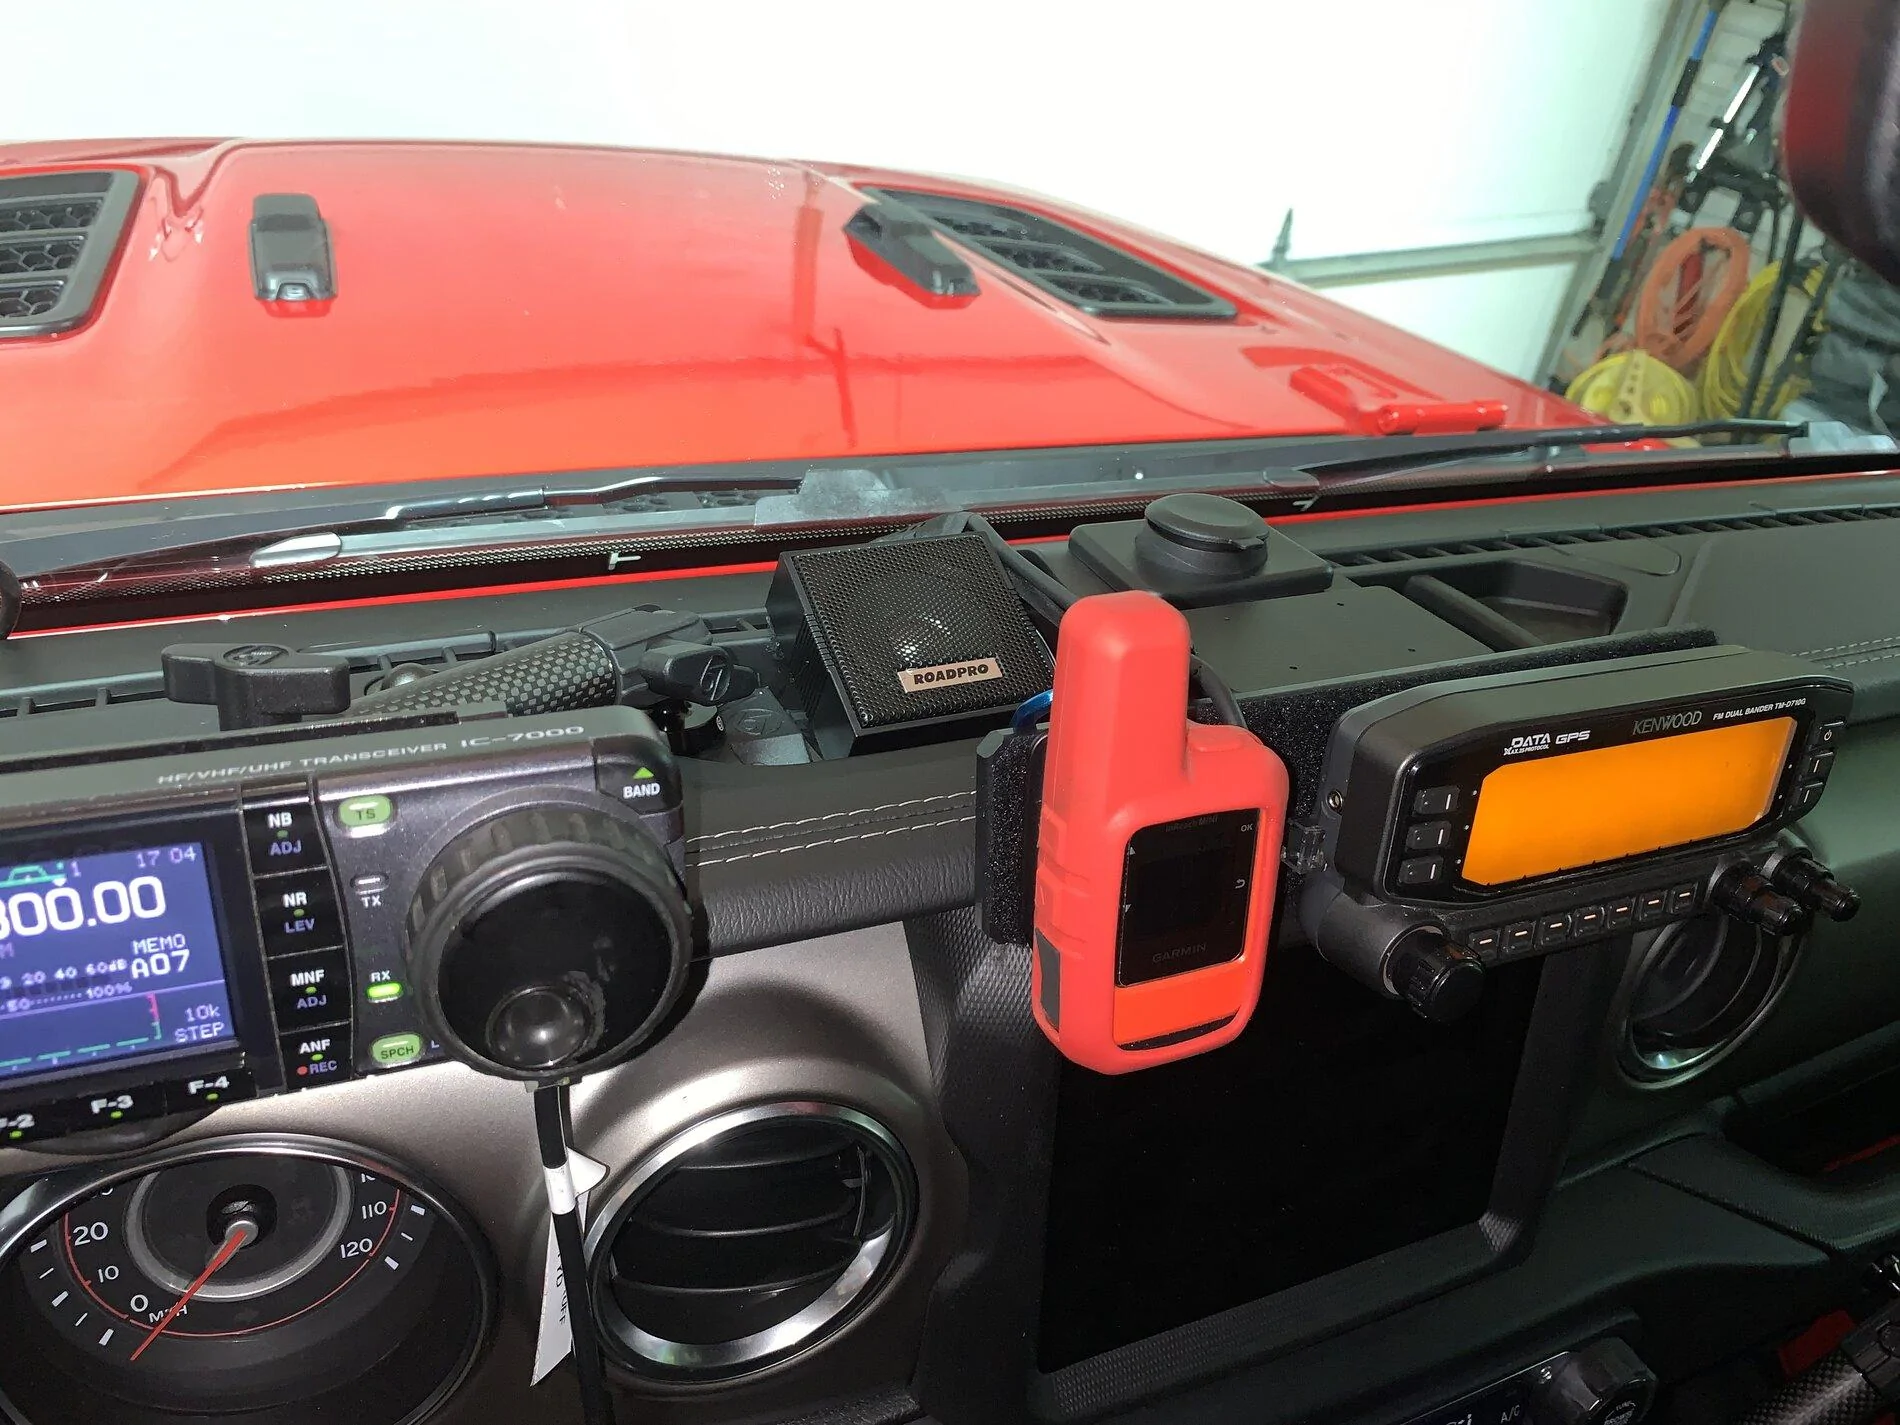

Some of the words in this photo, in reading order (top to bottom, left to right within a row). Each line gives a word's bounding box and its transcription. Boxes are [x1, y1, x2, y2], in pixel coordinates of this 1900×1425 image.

[914, 664, 989, 684] ROADPRO
[1712, 712, 1724, 721] FM
[1725, 709, 1743, 719] DUAL
[1744, 704, 1774, 715] BANDER
[1632, 711, 1703, 735] KENWOOD
[1511, 733, 1551, 748] DATA
[1555, 730, 1591, 744] GPS
[158, 760, 292, 784] HF/VHF/UHF
[299, 742, 448, 767] TRANSCEIVER
[461, 726, 585, 748] IC-7000
[623, 782, 661, 799] BAND
[267, 812, 293, 829] NB
[355, 808, 377, 822] TS
[1240, 823, 1254, 832] OK
[270, 840, 302, 856] ADJ
[283, 891, 308, 908] NR
[361, 896, 382, 908] TX
[284, 917, 315, 934] LEV
[132, 933, 186, 955] MEMO
[1152, 943, 1207, 964] GARMIN
[131, 949, 190, 979] A07
[21, 970, 46, 987] 20
[54, 966, 78, 980] 40
[290, 969, 325, 986] MNF
[370, 970, 392, 983] RX
[297, 994, 327, 1009] ADJ
[185, 1003, 221, 1022] 10k
[174, 1021, 225, 1043] STEP
[300, 1038, 331, 1054] ANF
[380, 1044, 414, 1060] SPCH
[309, 1060, 338, 1075] REC
[188, 1075, 230, 1095] F-4
[91, 1094, 134, 1114] F-3
[362, 1201, 387, 1219] 110
[73, 1221, 109, 1246] 20
[340, 1238, 373, 1259] 120
[98, 1265, 119, 1283] 10
[130, 1294, 149, 1312] 0
[1501, 1404, 1520, 1423] A/C
